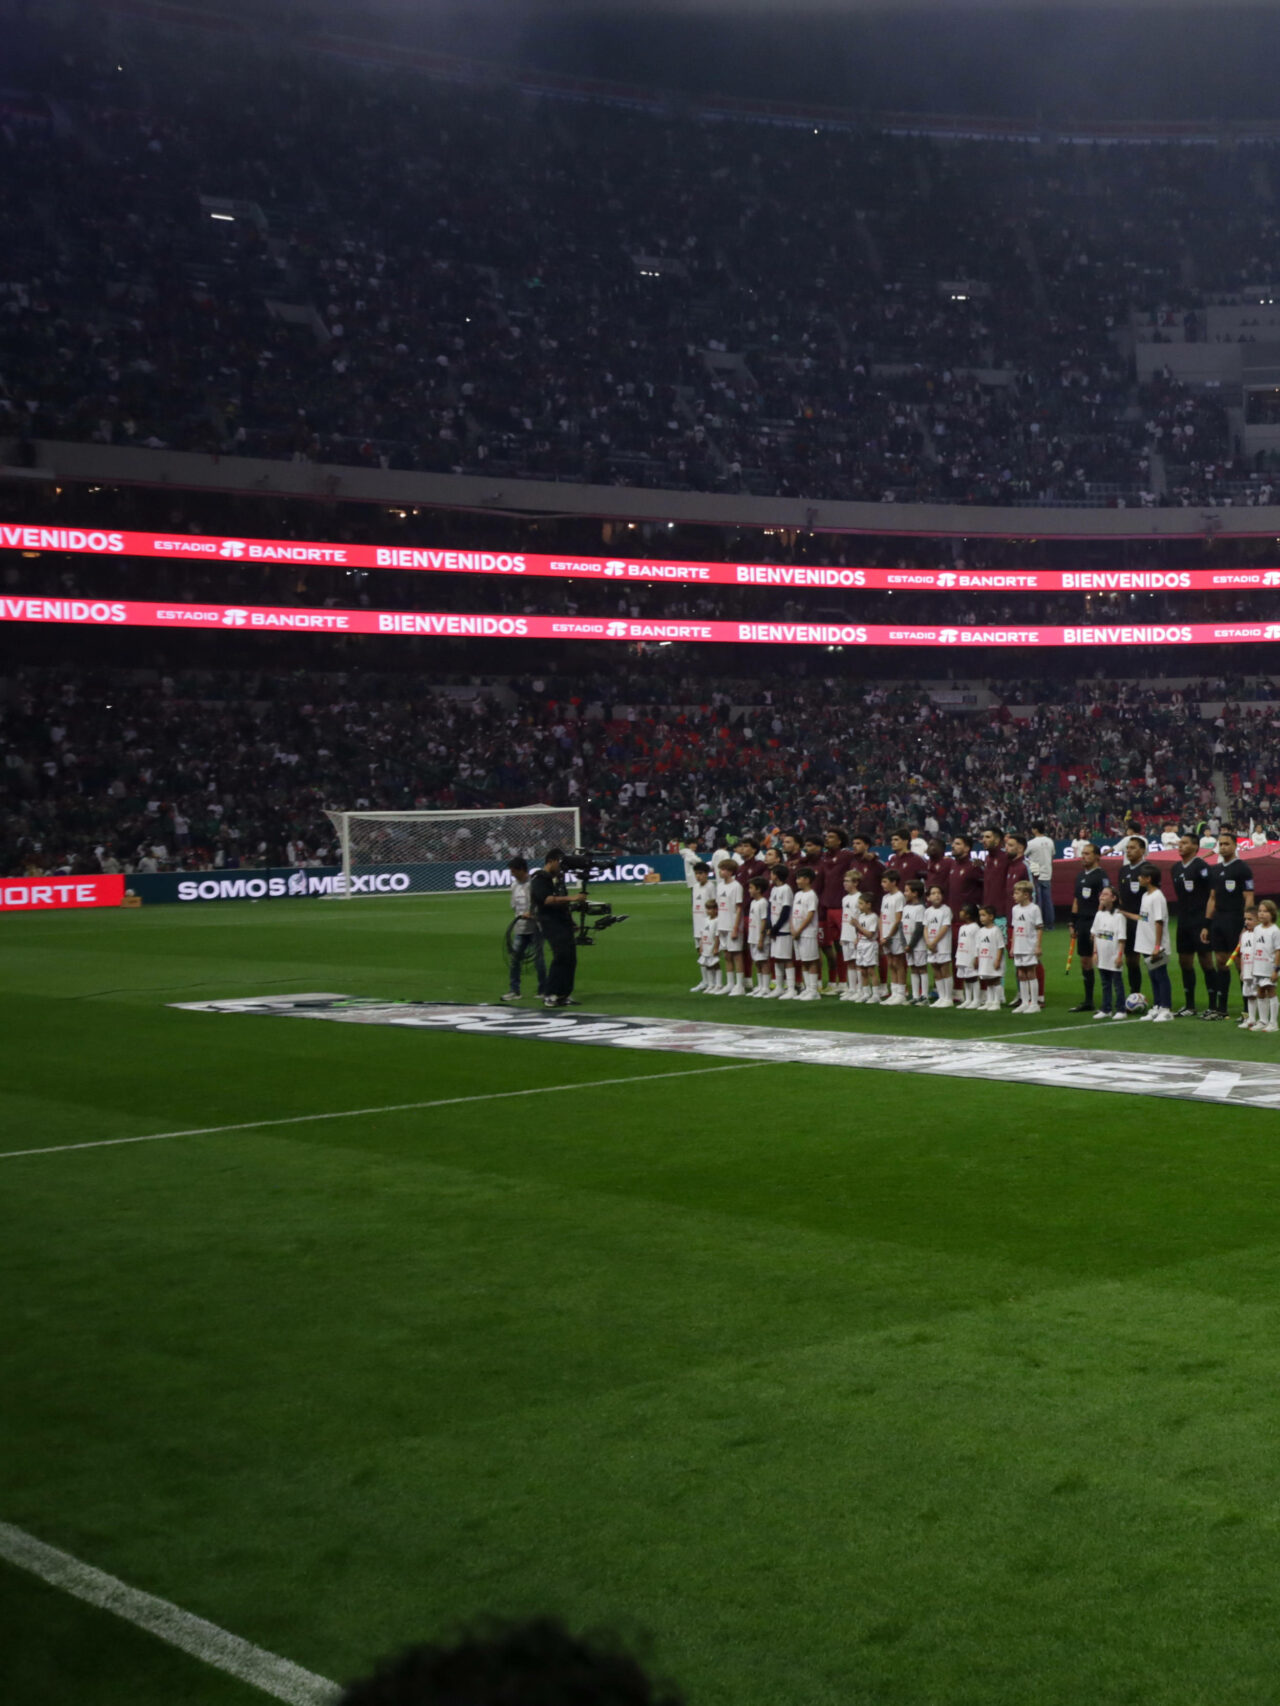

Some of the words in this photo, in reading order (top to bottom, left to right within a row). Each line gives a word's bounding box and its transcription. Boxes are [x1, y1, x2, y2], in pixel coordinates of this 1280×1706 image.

[0, 527, 124, 551] VENIDOS
[154, 541, 217, 552] ESTADIO
[248, 546, 347, 562] BANORTE
[376, 549, 527, 572] BIENVENIDOS
[550, 562, 602, 571] ESTADIO
[627, 565, 710, 579] BANORTE
[736, 566, 867, 586] BIENVENIDOS
[1212, 575, 1261, 583] ESTADIO
[887, 575, 935, 583] ESTADIO
[958, 576, 1038, 587] BANORTE
[1061, 572, 1192, 588] BIENVENIDOS
[0, 599, 127, 621] VENIDOS
[156, 610, 219, 621] ESTADIO
[251, 613, 350, 628] BANORTE
[378, 614, 529, 635] BIENVENIDOS
[551, 624, 604, 633] ESTADIO
[629, 625, 713, 638] BANORTE
[738, 624, 869, 642] BIENVENIDOS
[1213, 628, 1263, 637] ESTADIO
[888, 631, 937, 640] ESTADIO
[960, 631, 1040, 642] BANORTE
[1062, 627, 1193, 643] BIENVENIDOS
[0, 884, 96, 905] ORTE
[177, 877, 288, 900] SOMOS
[309, 872, 410, 894] MÉXICO
